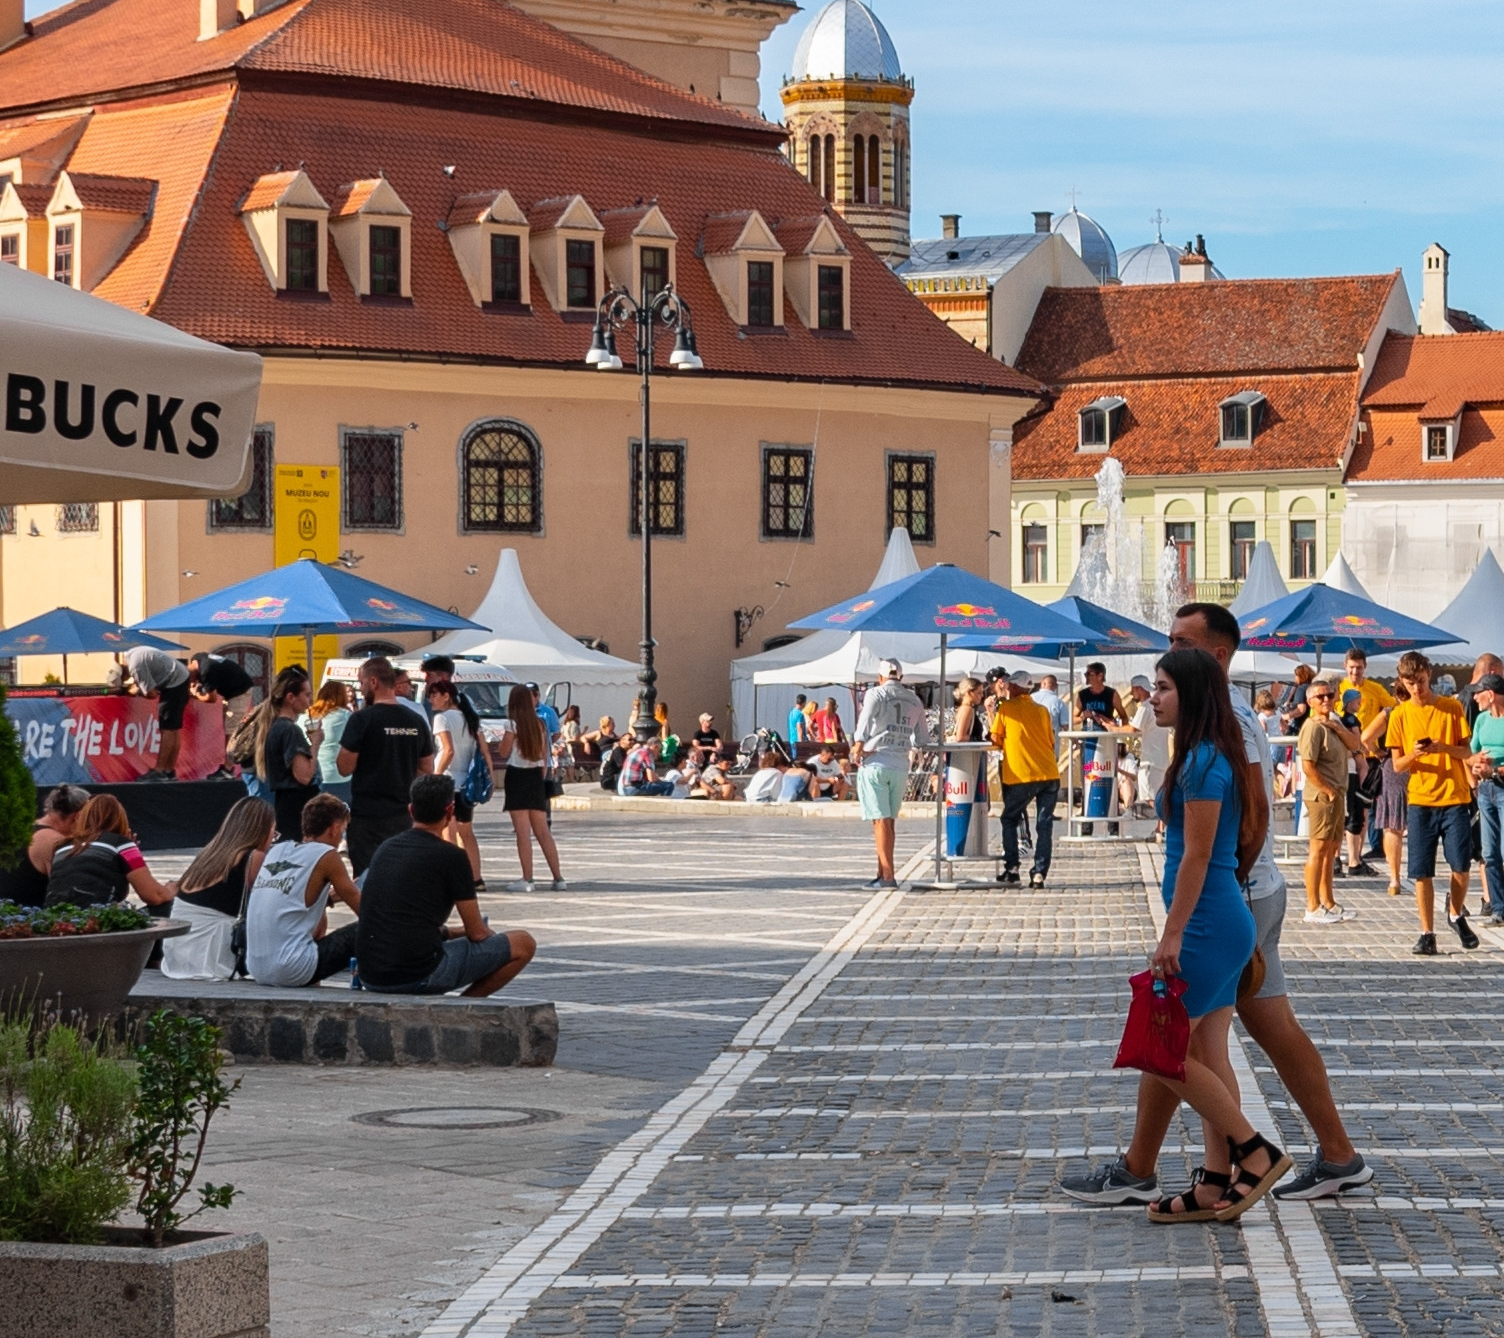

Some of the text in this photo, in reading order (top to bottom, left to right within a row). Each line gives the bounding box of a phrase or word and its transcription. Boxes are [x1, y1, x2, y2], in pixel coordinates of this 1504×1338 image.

[285, 489, 330, 498] MUZEU NOU
[60, 714, 104, 766] THE
[109, 714, 161, 756] LOVE
[1093, 760, 1111, 771] Bull
[946, 782, 967, 795] Bull
